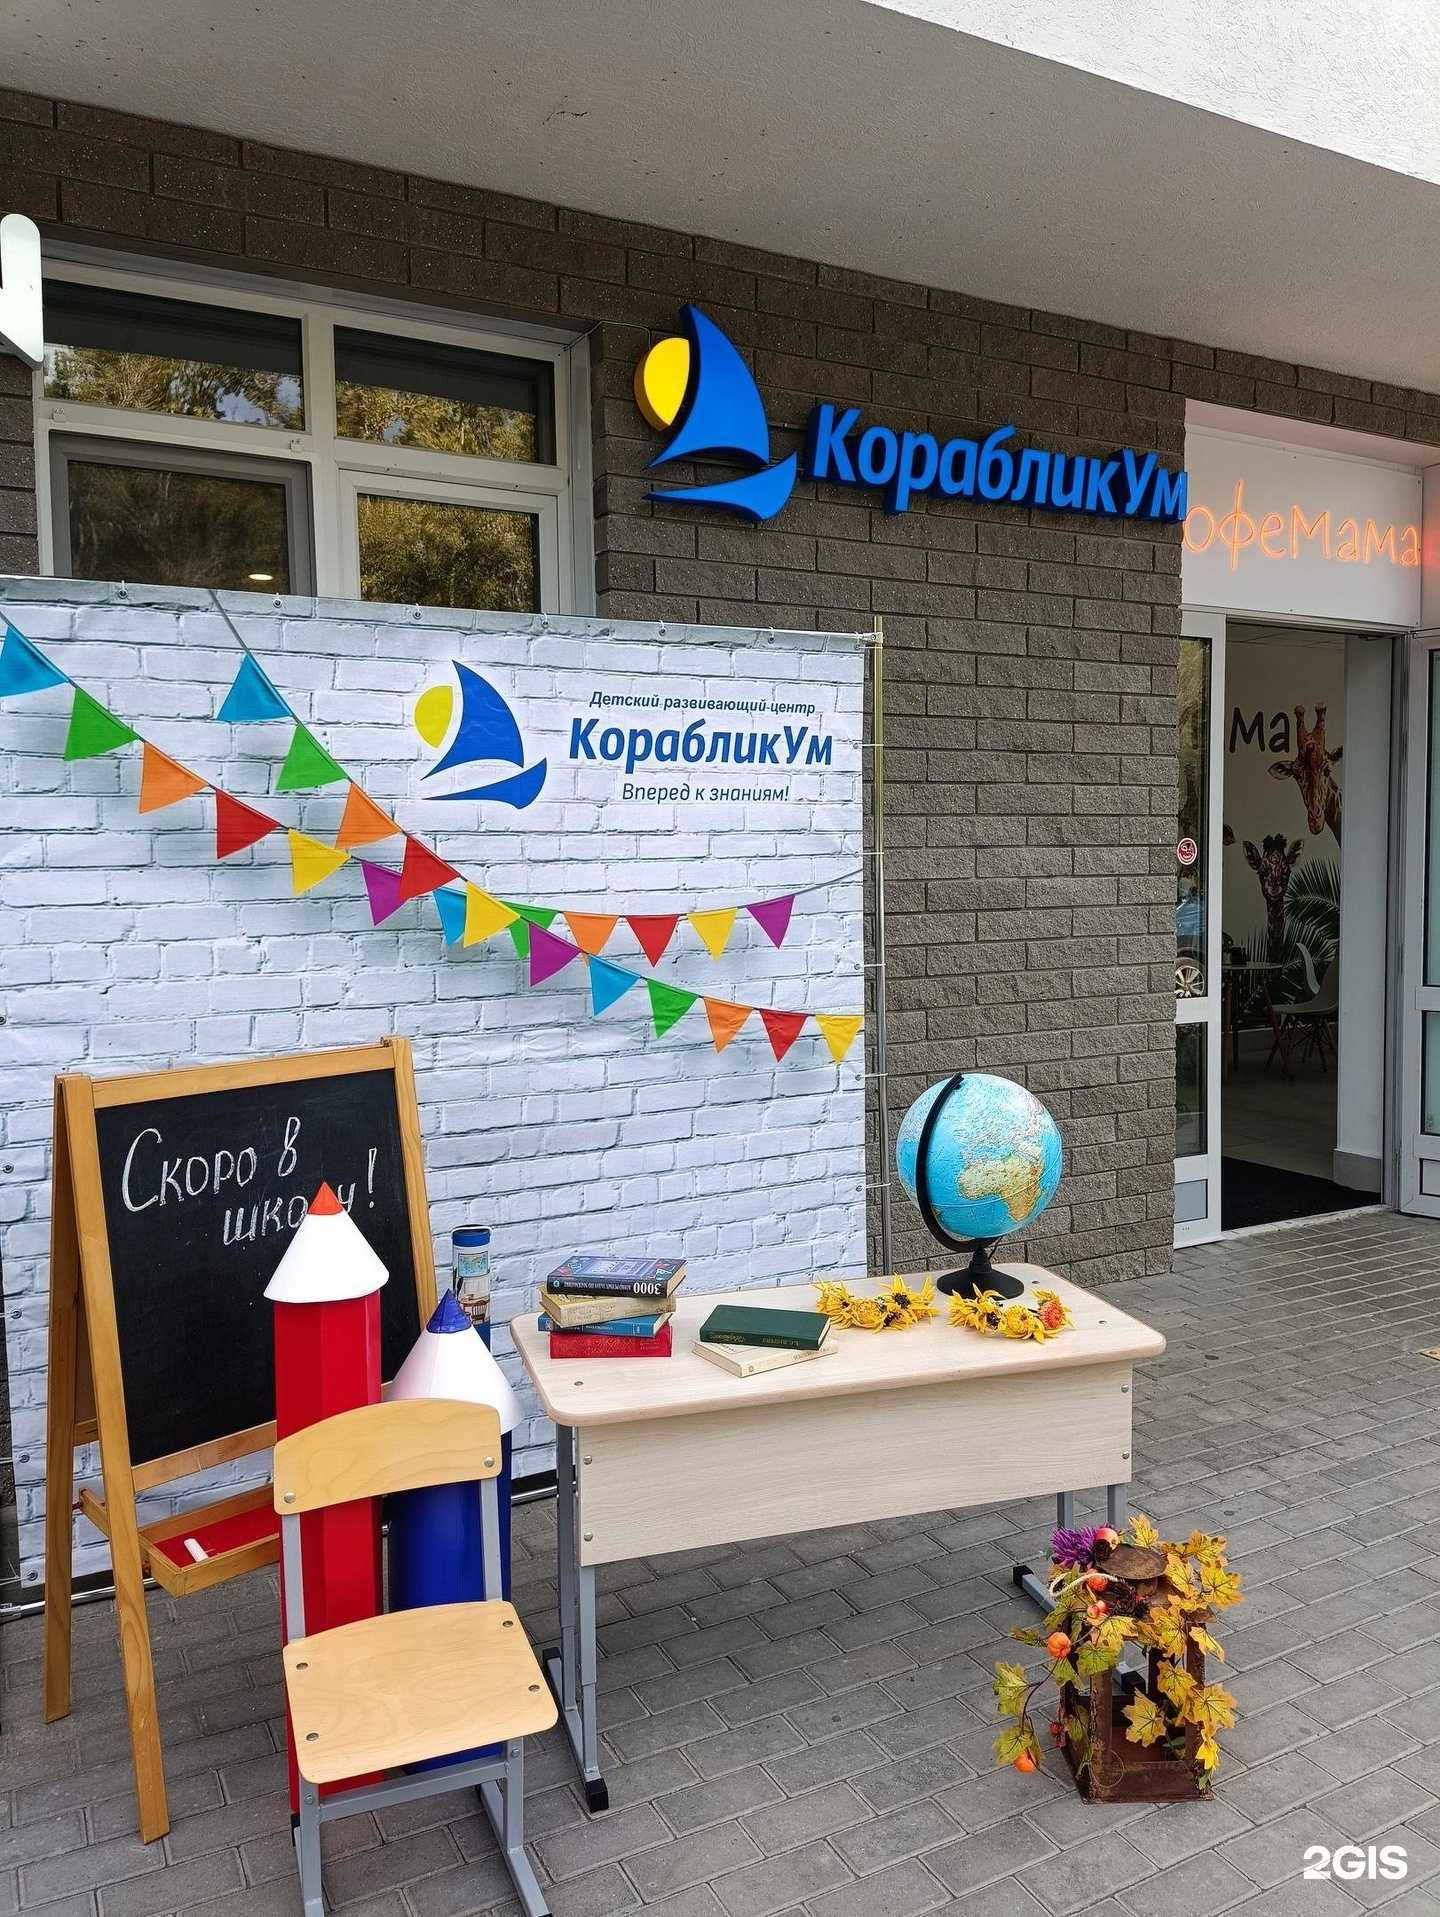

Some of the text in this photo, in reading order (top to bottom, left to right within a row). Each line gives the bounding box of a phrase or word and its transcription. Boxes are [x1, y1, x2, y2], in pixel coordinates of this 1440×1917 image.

[811, 403, 1188, 520] КорабликУм
[1183, 479, 1421, 571] офеМама
[589, 691, 816, 716] Детский развивающий центр
[569, 717, 833, 774] КорабликУм
[622, 783, 790, 804] Вперед к знаниям!
[121, 1127, 258, 1212] Скоро
[223, 1147, 378, 1245] шкоу!
[633, 1282, 662, 1295] 3000
